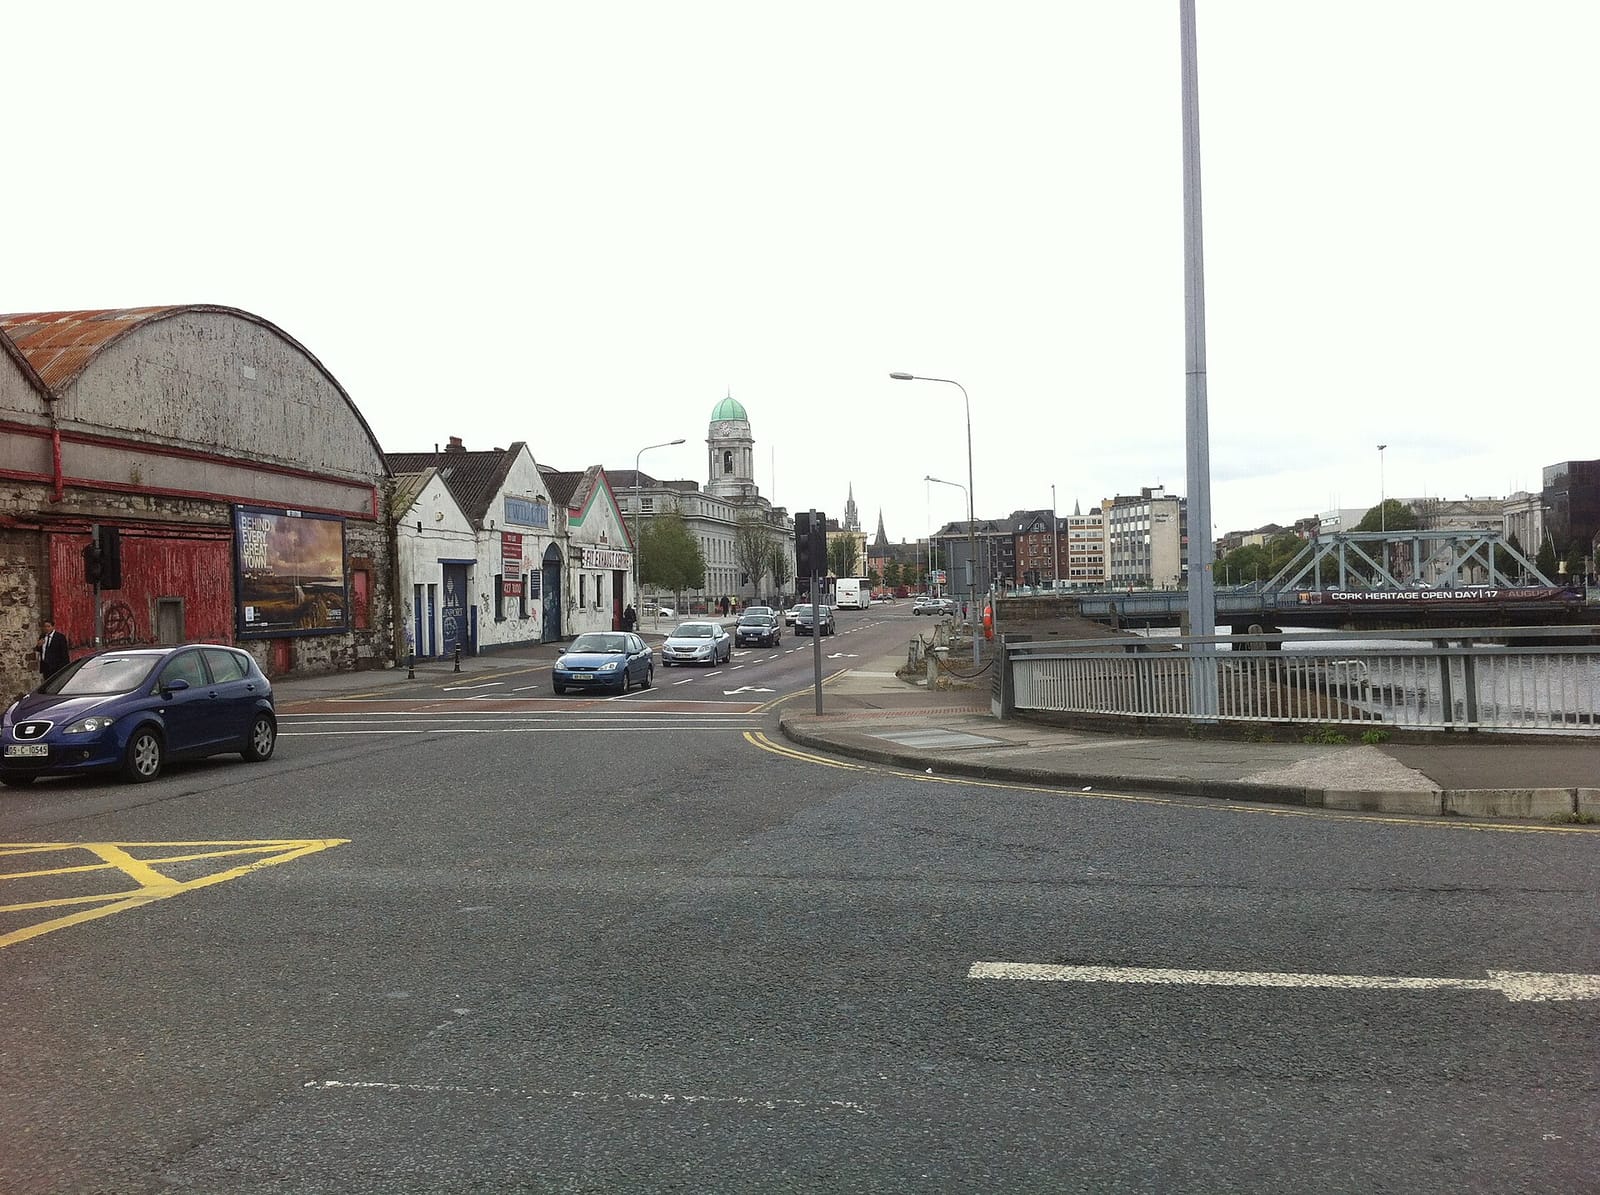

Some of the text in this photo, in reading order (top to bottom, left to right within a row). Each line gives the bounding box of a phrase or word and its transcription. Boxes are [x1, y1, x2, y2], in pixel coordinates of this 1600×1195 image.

[241, 516, 271, 531] BEHIND
[242, 530, 267, 543] EVERY
[243, 543, 268, 556] GREAT
[595, 551, 614, 568] EXHAUST
[1331, 590, 1554, 600] CORK HERITAGE OPEN DAY 17 AUGUST
